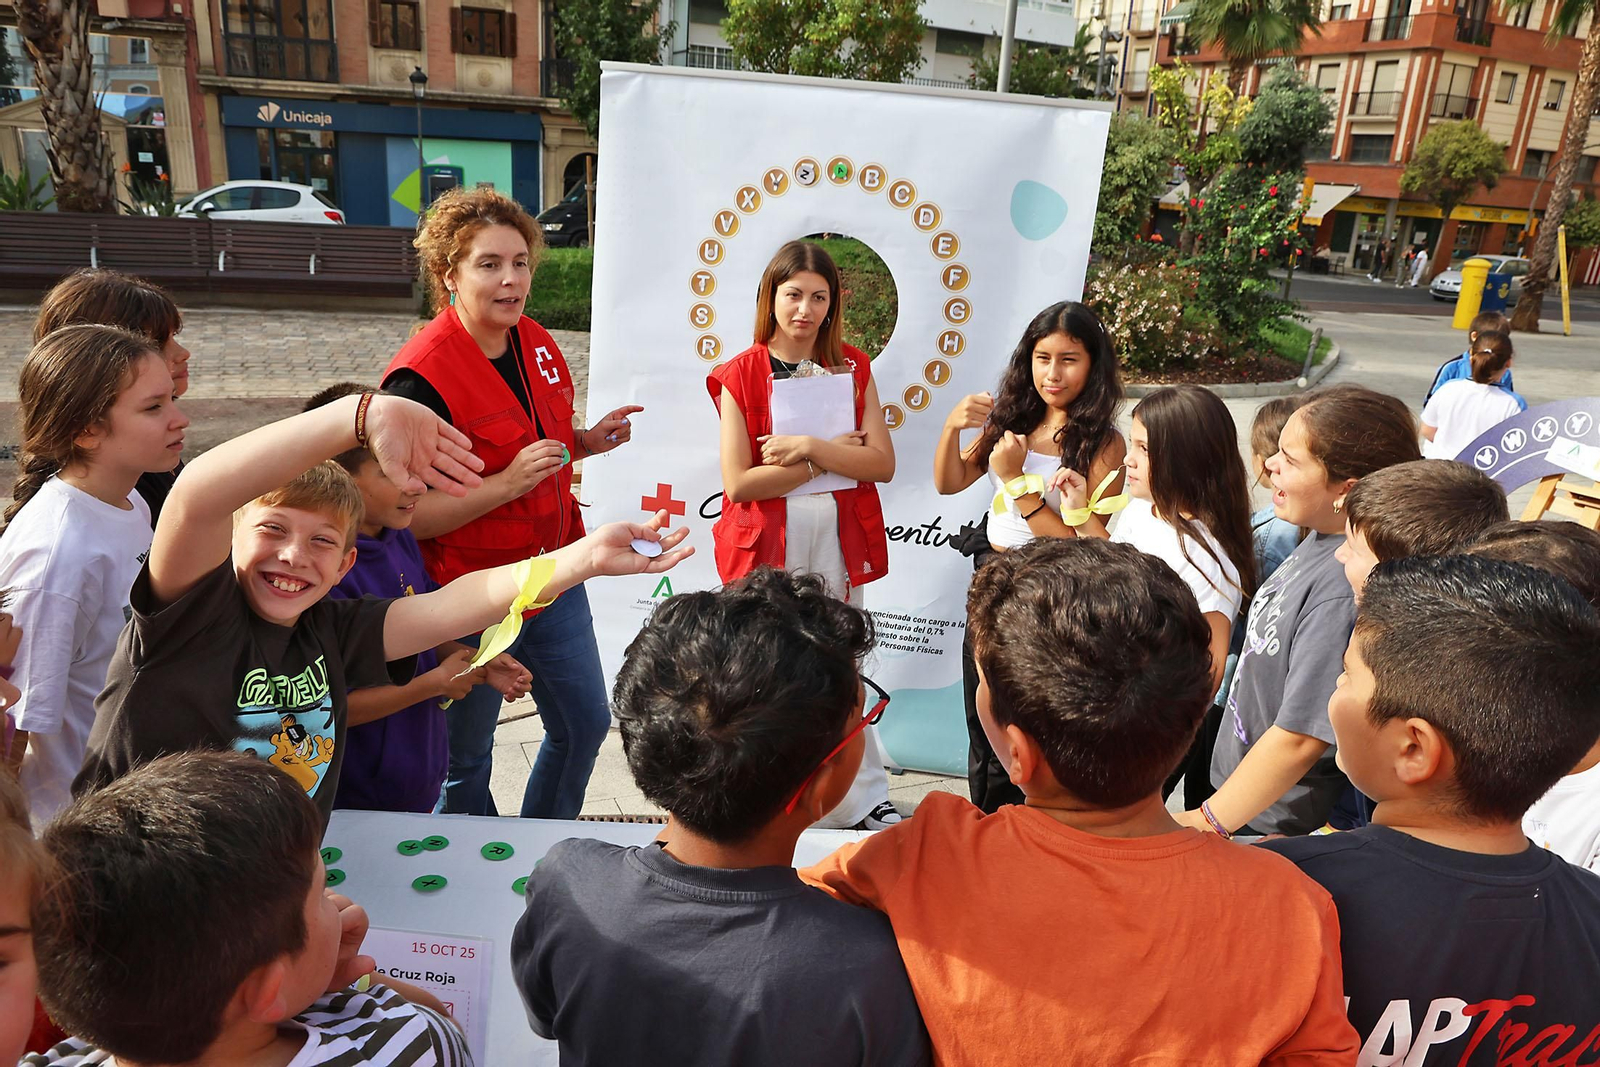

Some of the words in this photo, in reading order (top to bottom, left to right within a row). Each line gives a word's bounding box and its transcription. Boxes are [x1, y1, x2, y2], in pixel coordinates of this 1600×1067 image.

[283, 110, 332, 127] Unicaja
[770, 172, 783, 191] Y
[864, 169, 880, 187] B
[742, 190, 755, 209] X
[894, 185, 911, 203] C
[720, 214, 734, 232] V
[919, 208, 935, 226] D
[704, 243, 718, 260] U
[938, 237, 952, 255] E
[696, 274, 710, 292] T
[949, 269, 962, 286] F
[695, 307, 709, 324] S
[949, 302, 966, 320] G
[701, 338, 716, 356] R
[943, 334, 959, 352] H
[911, 390, 923, 406] J
[1537, 419, 1553, 439] X
[1571, 415, 1587, 434] Y
[1504, 430, 1522, 450] W
[877, 621, 911, 632] tributaria
[913, 625, 926, 634] del
[926, 627, 945, 636] 0,7%
[912, 616, 927, 624] con
[928, 619, 950, 628] cargo
[958, 620, 966, 628] la
[876, 631, 897, 640] uesto
[899, 633, 921, 643] sobre
[921, 636, 930, 644] la
[880, 640, 915, 653] Personas
[916, 645, 944, 655] Físicas
[411, 942, 427, 953] 15
[430, 944, 457, 956] OCT
[460, 947, 475, 959] 25
[389, 967, 421, 980] Cruz
[425, 971, 455, 985] Roja
